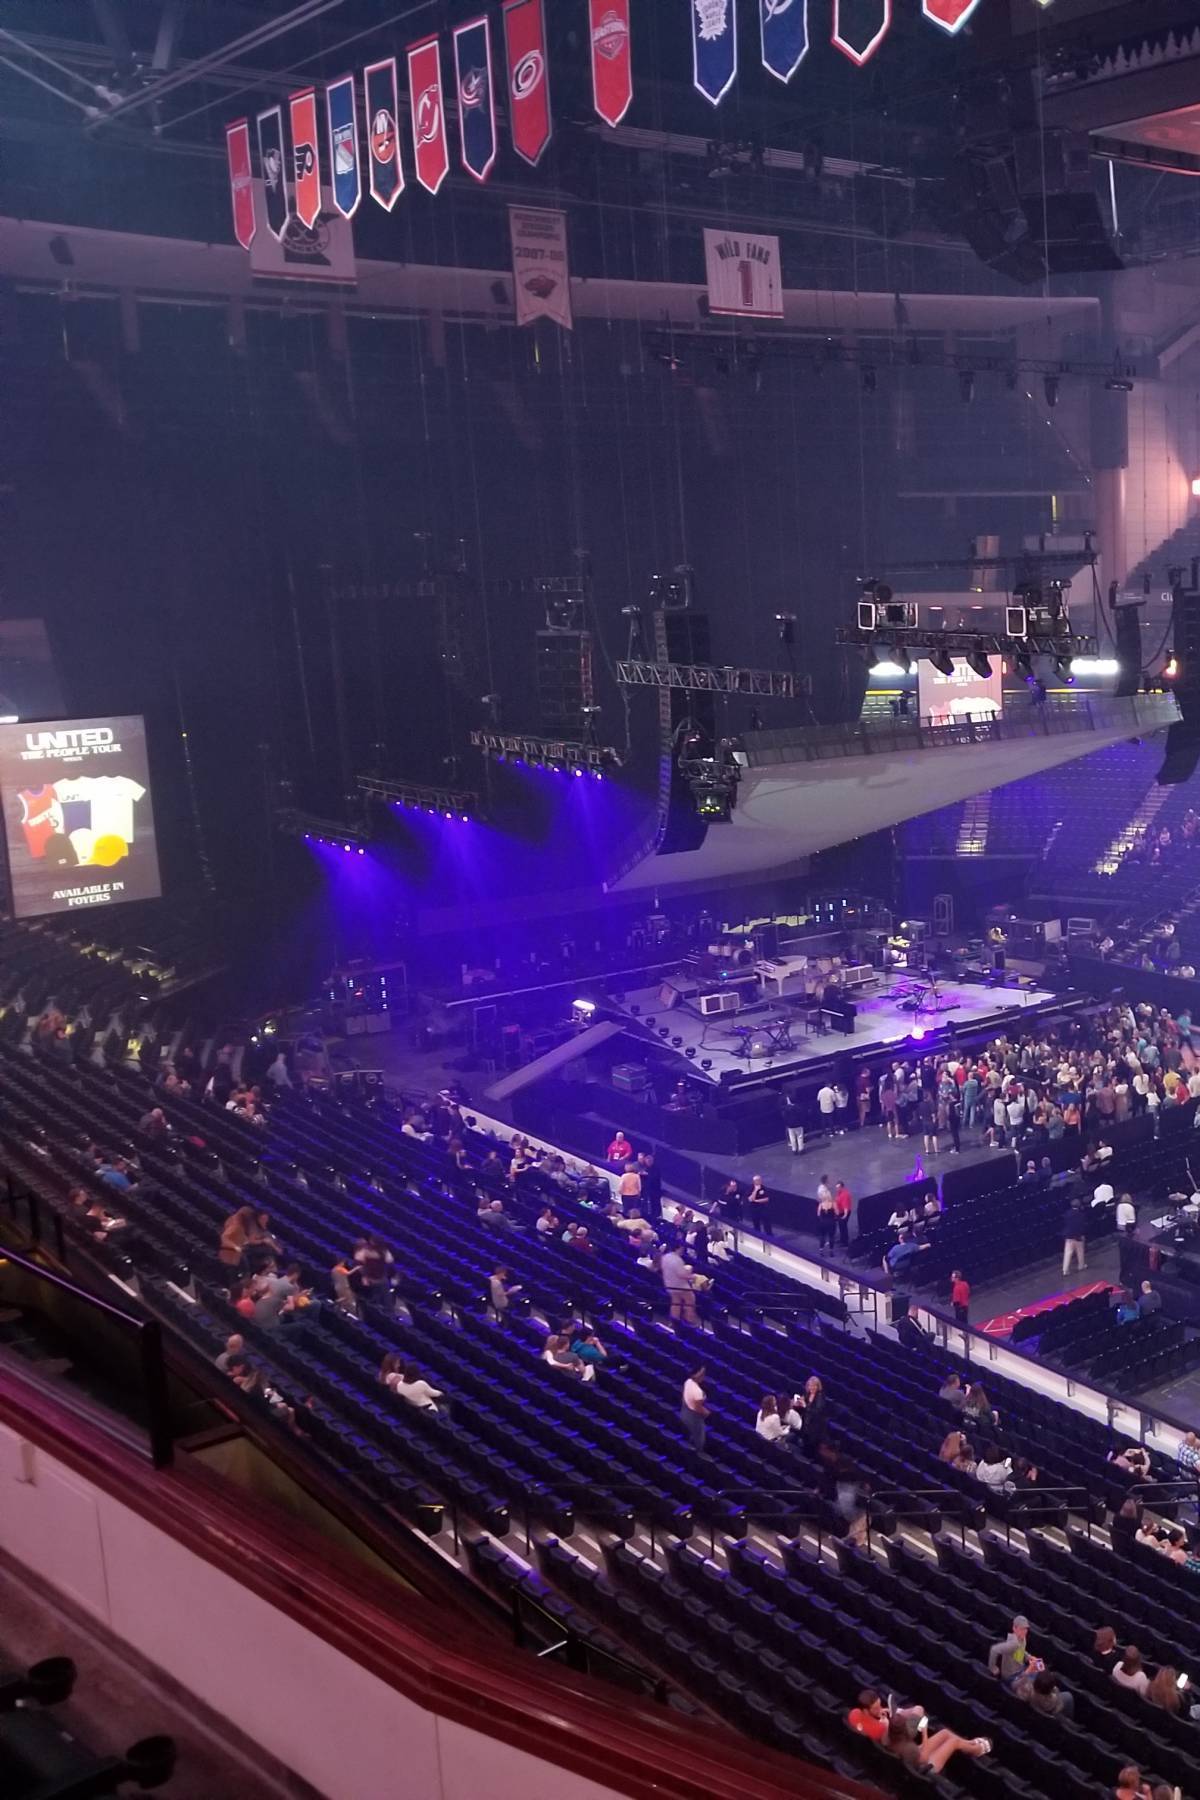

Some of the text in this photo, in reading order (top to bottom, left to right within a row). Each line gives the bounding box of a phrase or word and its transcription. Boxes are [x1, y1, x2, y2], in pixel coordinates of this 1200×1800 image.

[737, 260, 753, 306] 1
[26, 727, 114, 751] UNITED
[20, 743, 122, 761] THE PEOPLE TOUR
[52, 881, 124, 899] AVAILABLE IN
[68, 892, 111, 907] FOYERS
